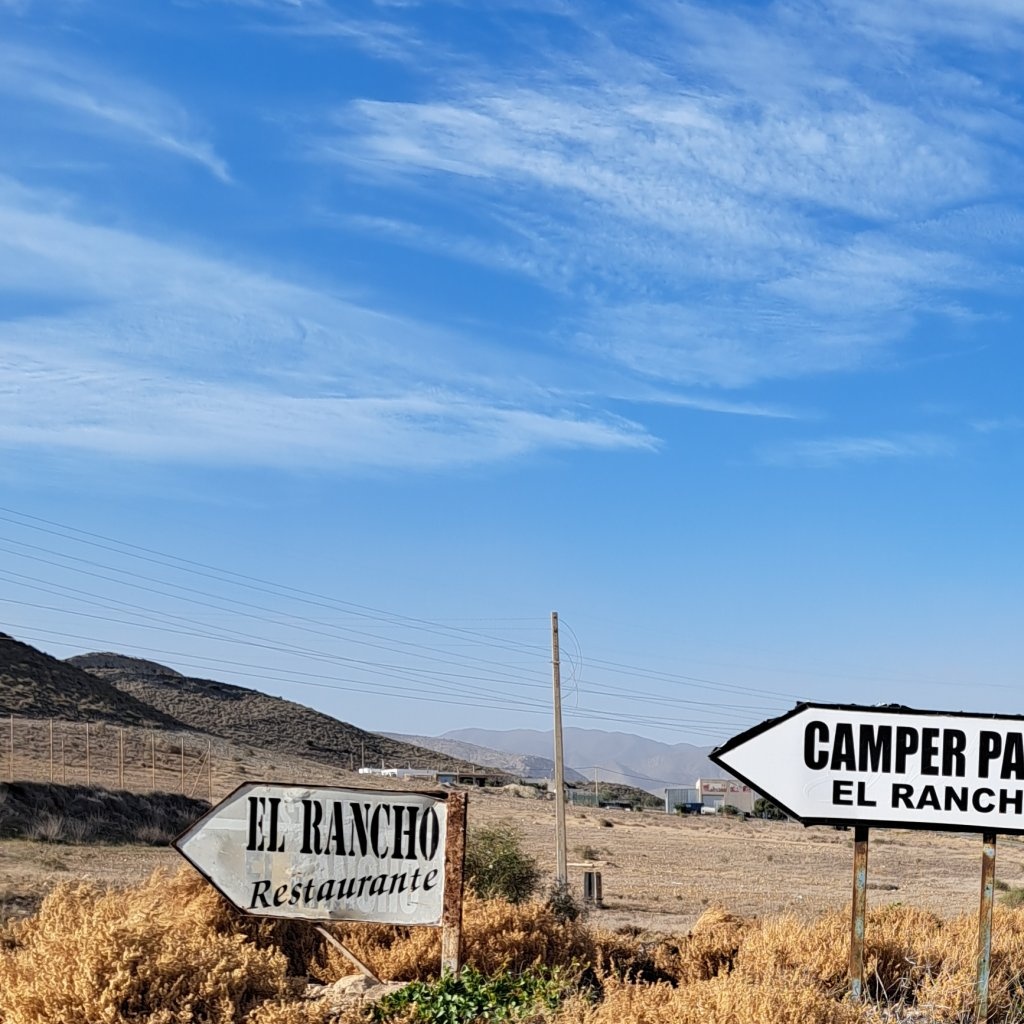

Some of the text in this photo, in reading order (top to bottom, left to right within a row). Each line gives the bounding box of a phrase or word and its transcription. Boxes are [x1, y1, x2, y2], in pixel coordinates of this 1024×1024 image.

[803, 720, 967, 777] CAMPER
[832, 780, 877, 807] EL
[246, 796, 440, 861] EL RANCHO
[247, 868, 439, 910] Restaurante
